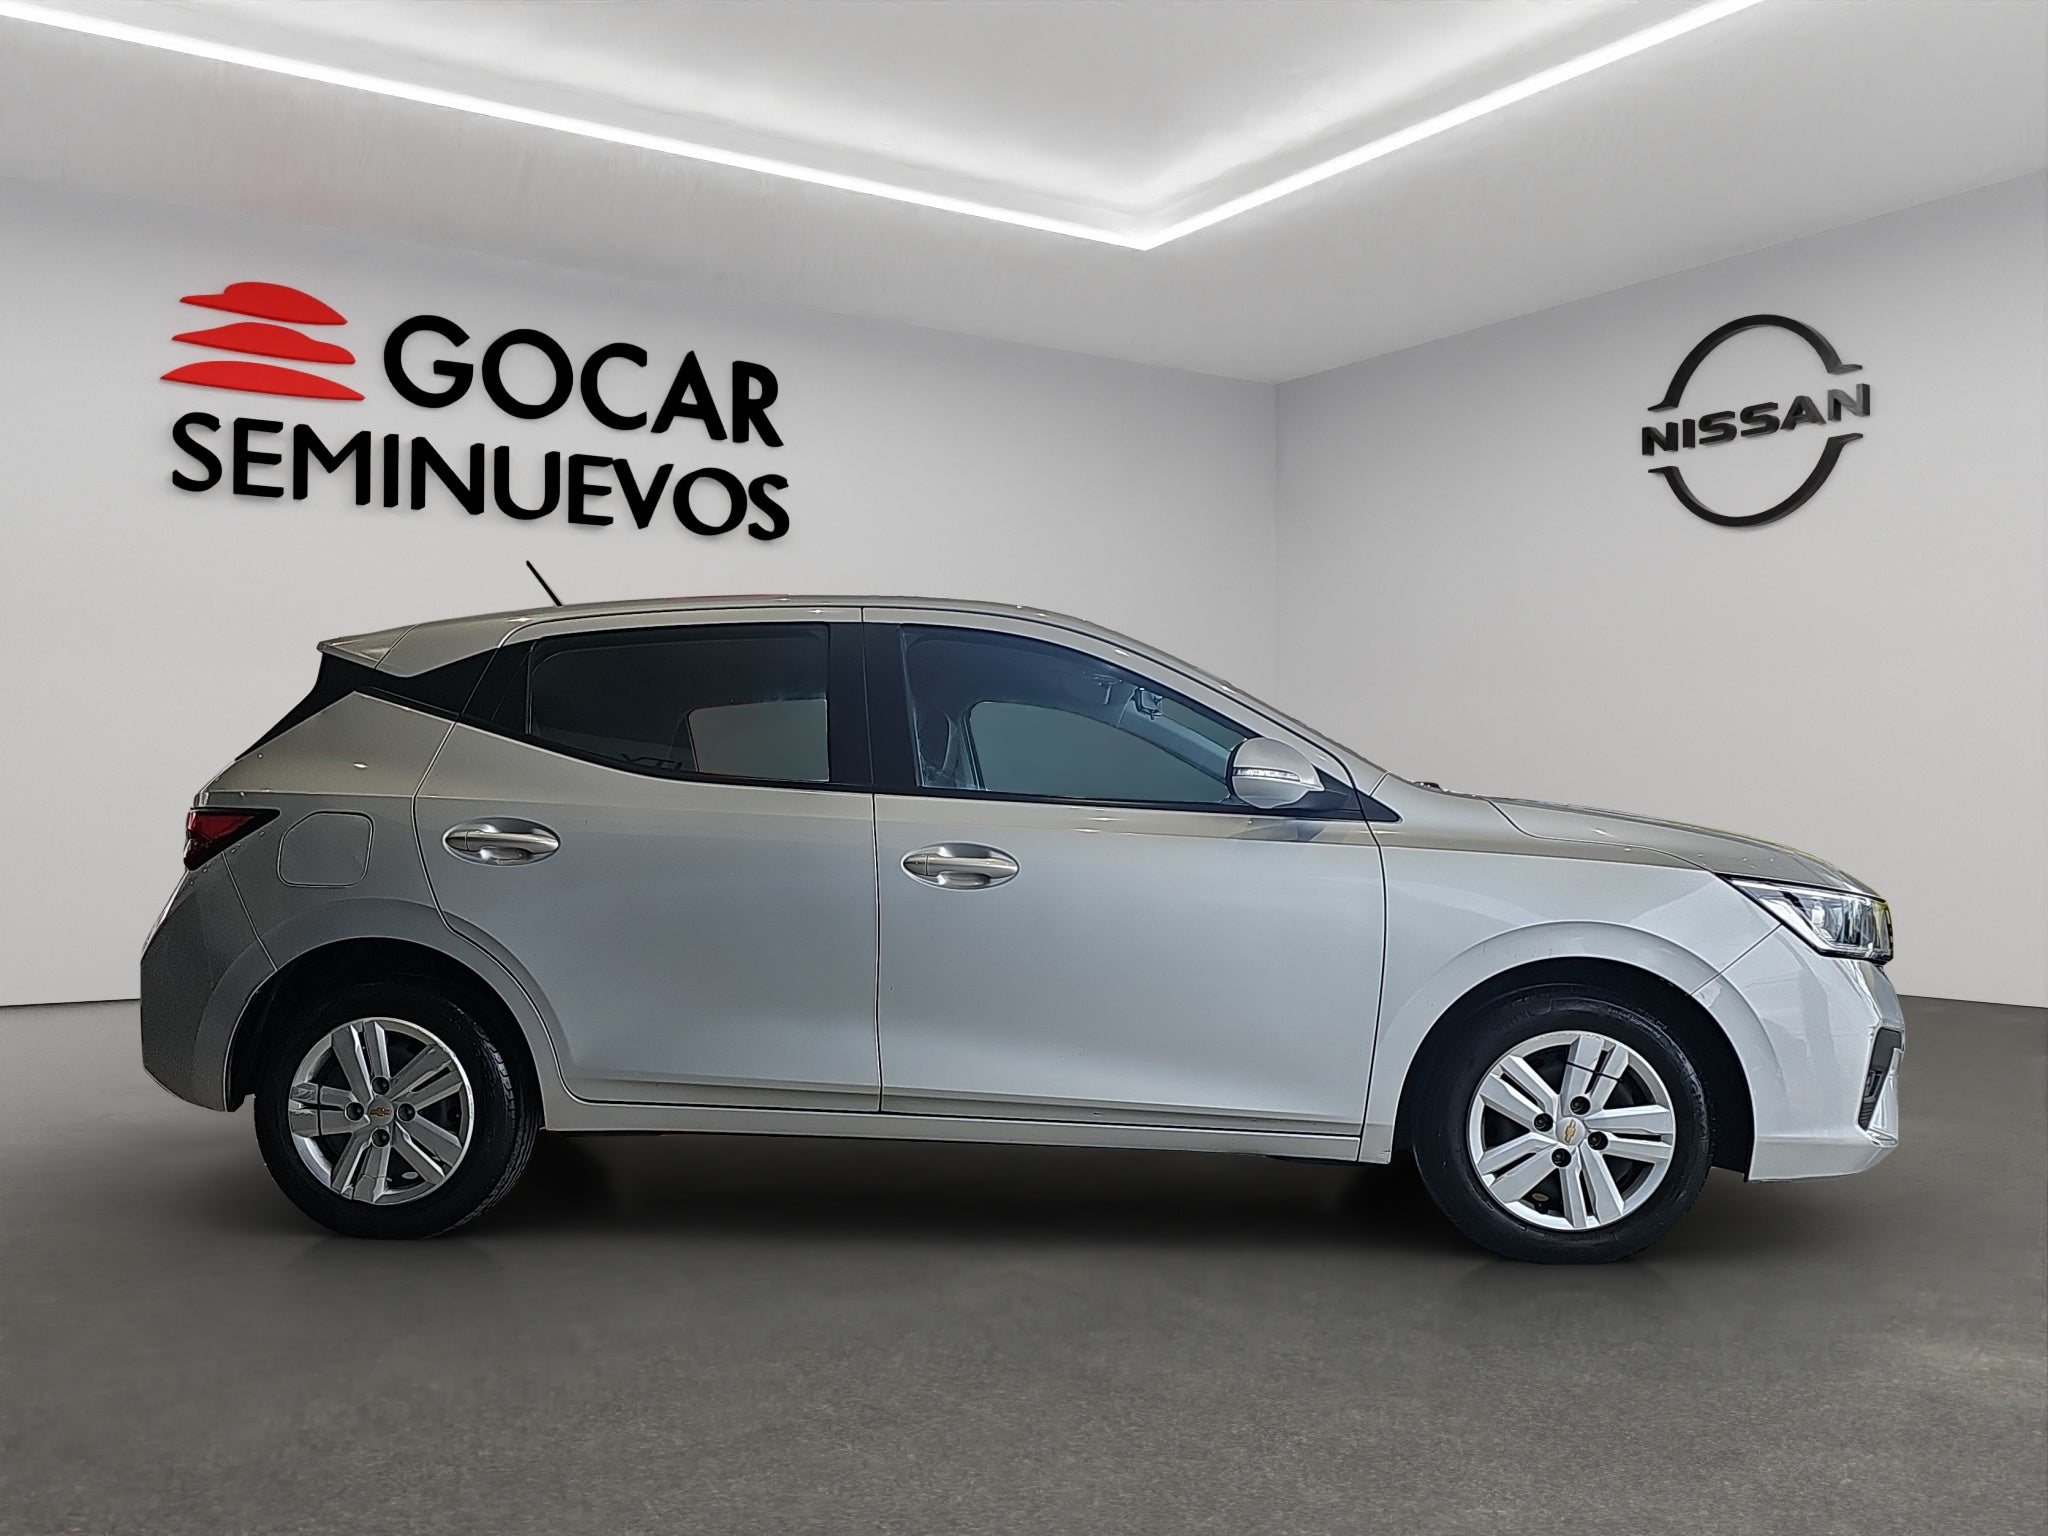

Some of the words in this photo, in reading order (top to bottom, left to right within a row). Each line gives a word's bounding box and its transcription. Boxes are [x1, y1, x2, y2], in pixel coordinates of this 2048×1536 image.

[383, 314, 784, 448] GOCAR
[1641, 383, 1871, 457] NISSAN
[172, 411, 790, 542] SEMINUEVOS
